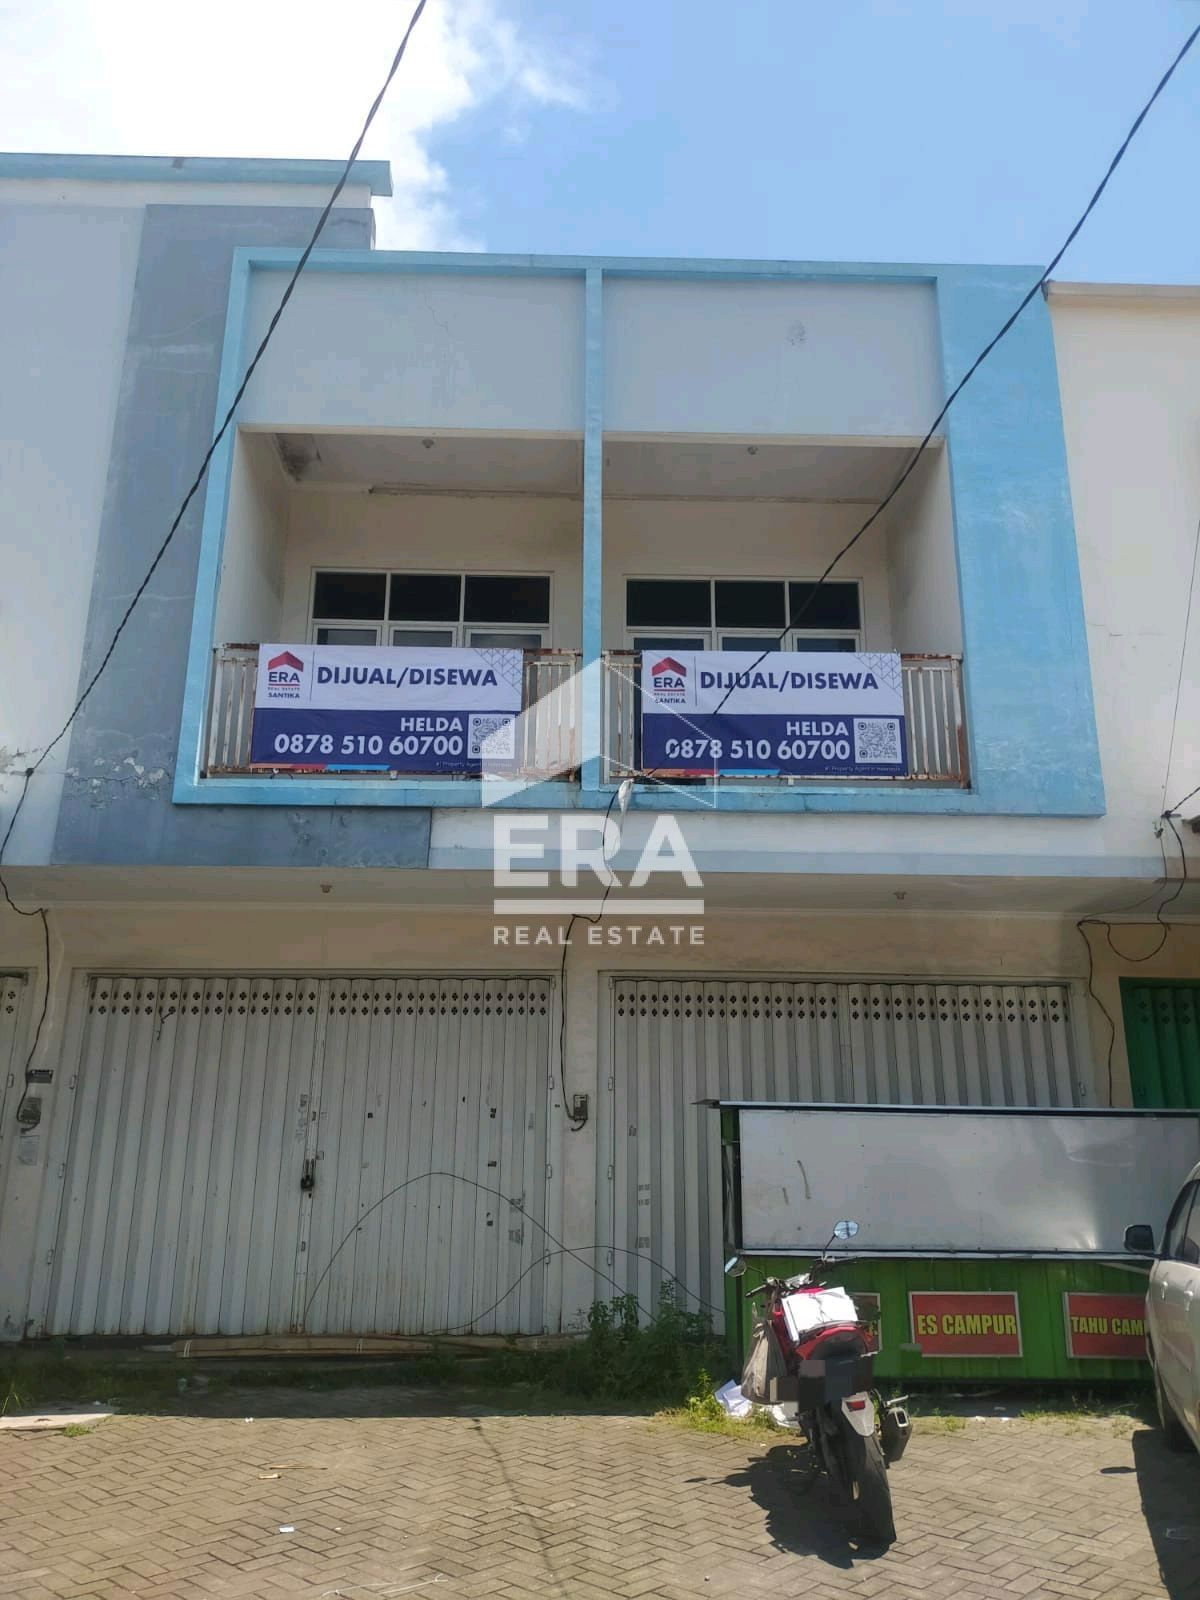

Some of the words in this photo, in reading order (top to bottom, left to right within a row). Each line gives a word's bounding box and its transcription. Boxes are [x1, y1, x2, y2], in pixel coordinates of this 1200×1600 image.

[268, 671, 300, 683] ERA
[317, 666, 498, 688] DIJUAL/DISEWA
[653, 677, 685, 688] ERA
[700, 670, 879, 692] DIJUAL/DISEWA
[400, 717, 464, 732] HELDA
[786, 721, 850, 736] HELDA
[274, 733, 334, 754] 0878
[341, 735, 384, 755] 510
[389, 735, 464, 756] 60700
[665, 739, 723, 759] 0878
[730, 739, 772, 760] 510
[777, 739, 851, 760] 60700
[917, 1314, 938, 1335] ES
[941, 1314, 1017, 1335] CAMPUR
[1070, 1316, 1108, 1335] TAHU
[1111, 1318, 1147, 1336] CAM
